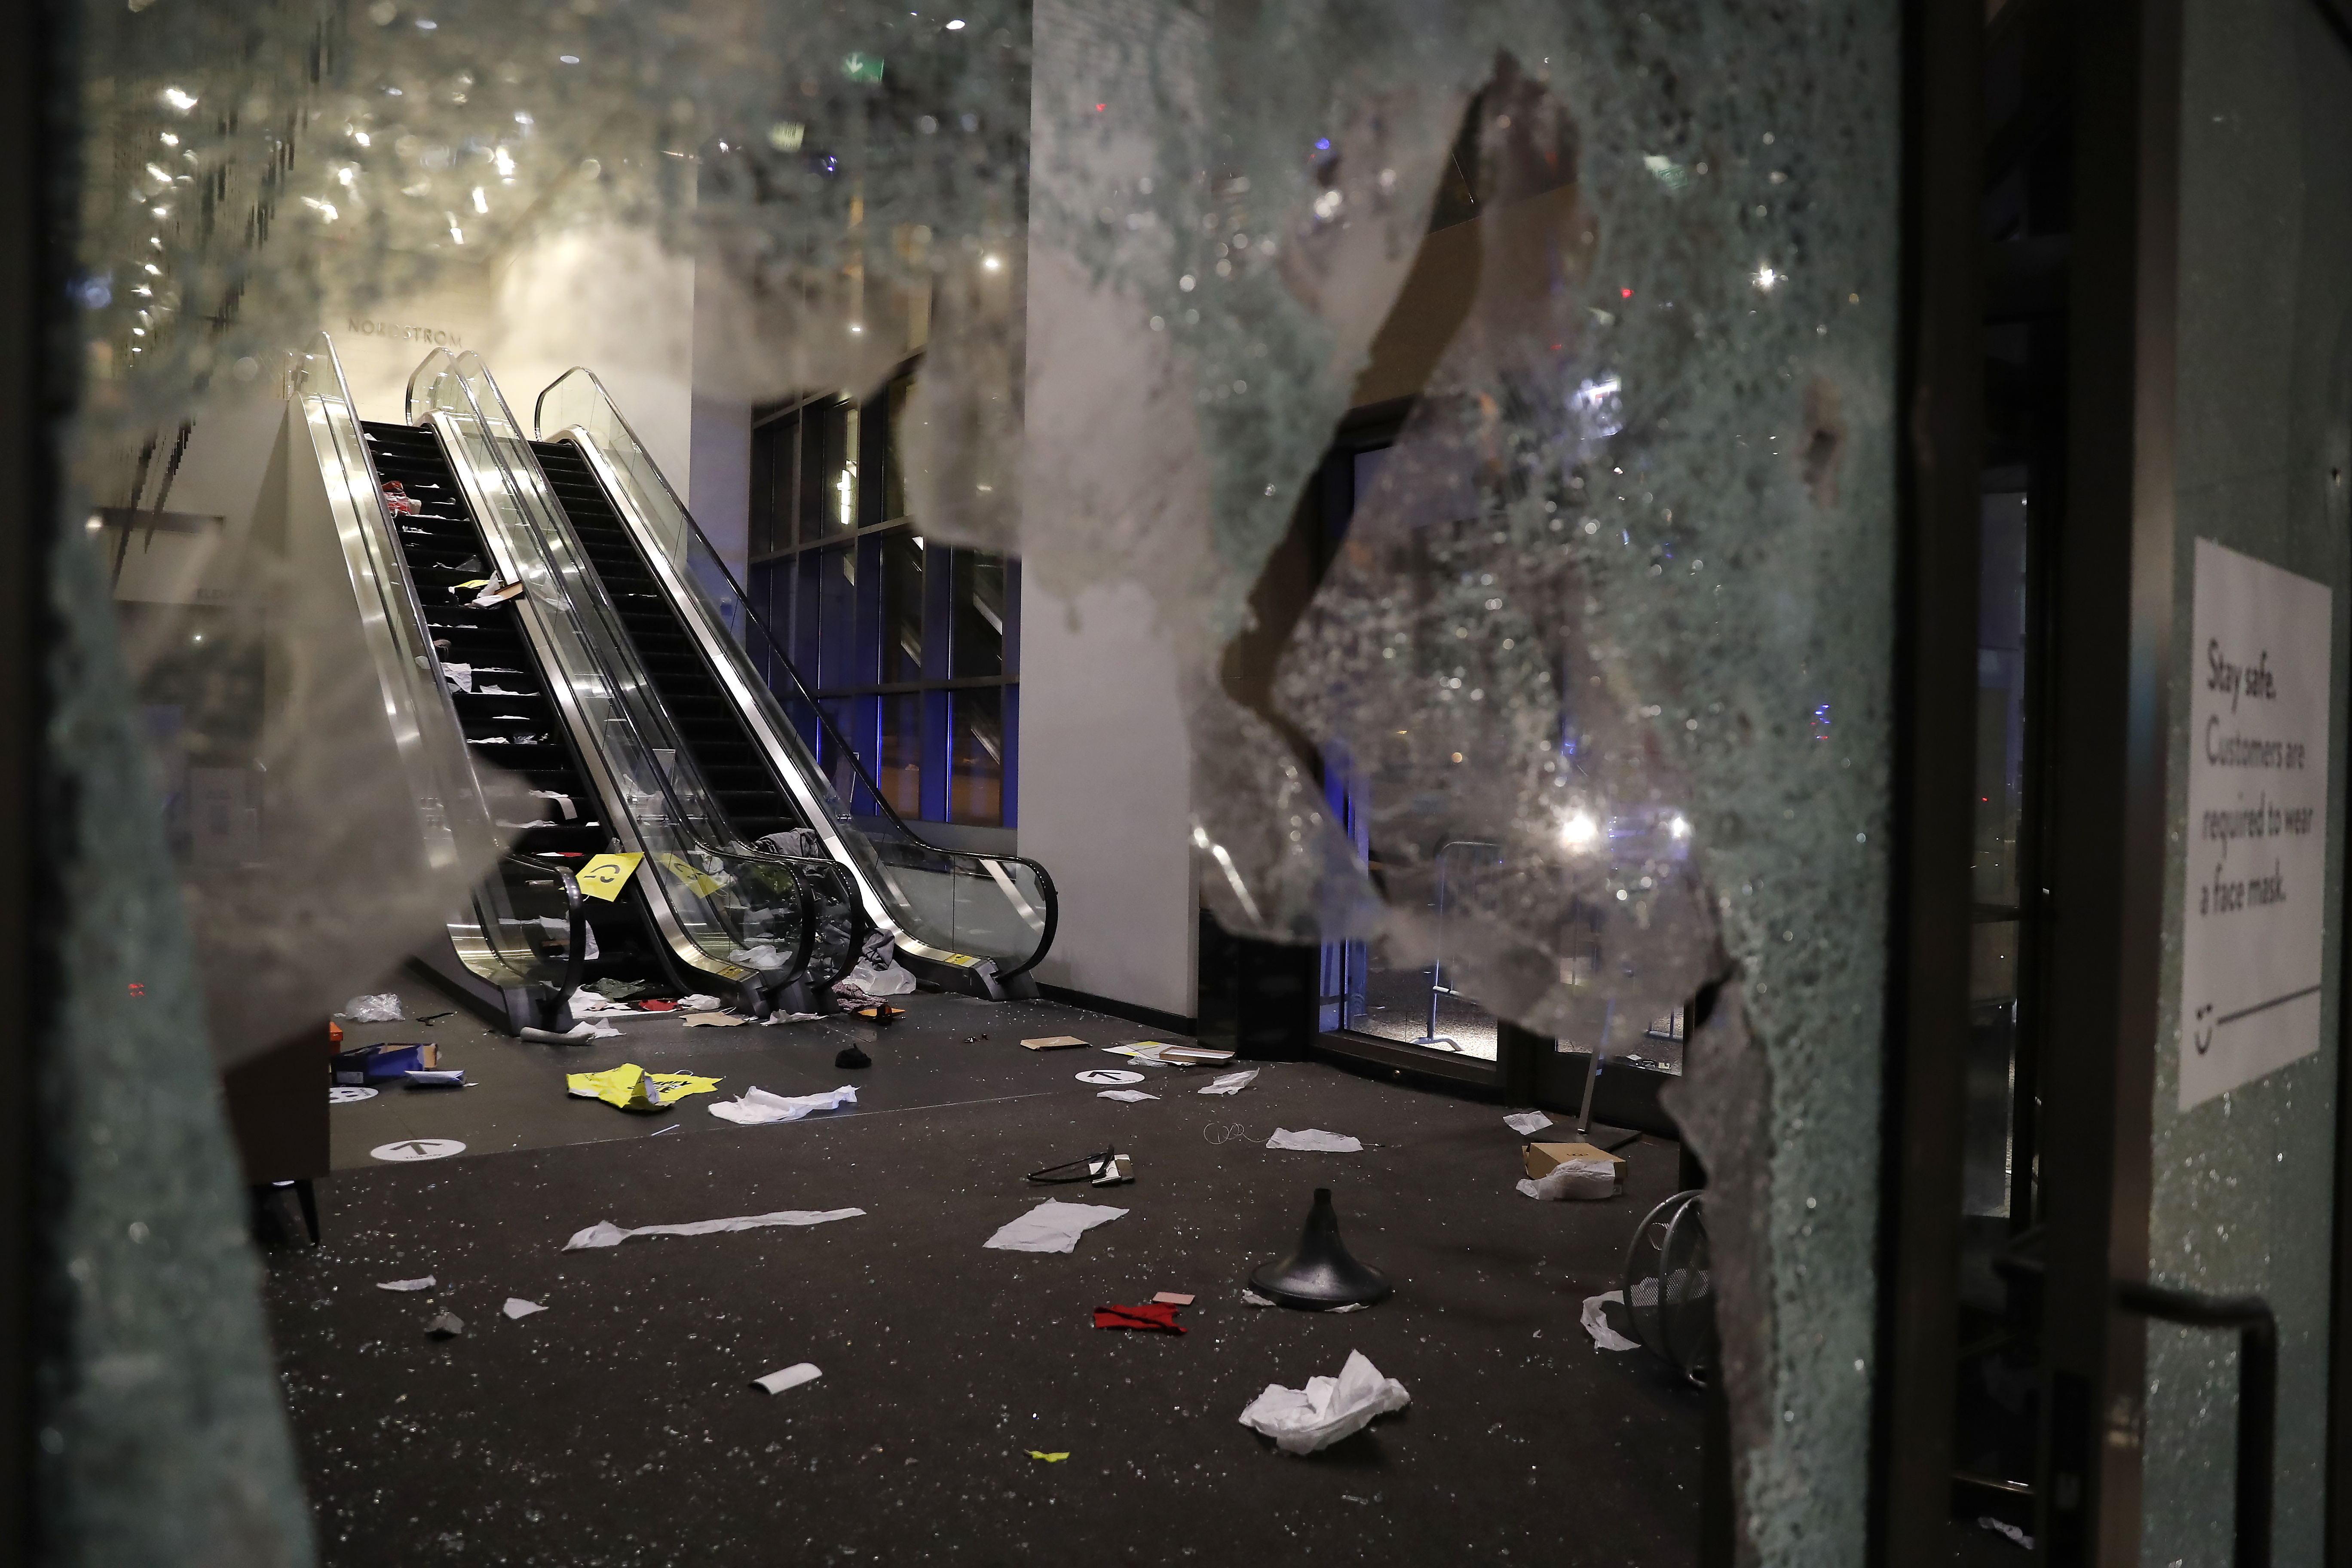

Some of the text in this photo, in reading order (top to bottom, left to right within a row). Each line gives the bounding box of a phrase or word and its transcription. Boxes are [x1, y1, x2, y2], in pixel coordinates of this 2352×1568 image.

[2207, 638, 2276, 714] Stay safe.
[2206, 714, 2305, 769] Customers are
[2202, 790, 2313, 860] required to wear
[2199, 857, 2286, 918] a face mask.
